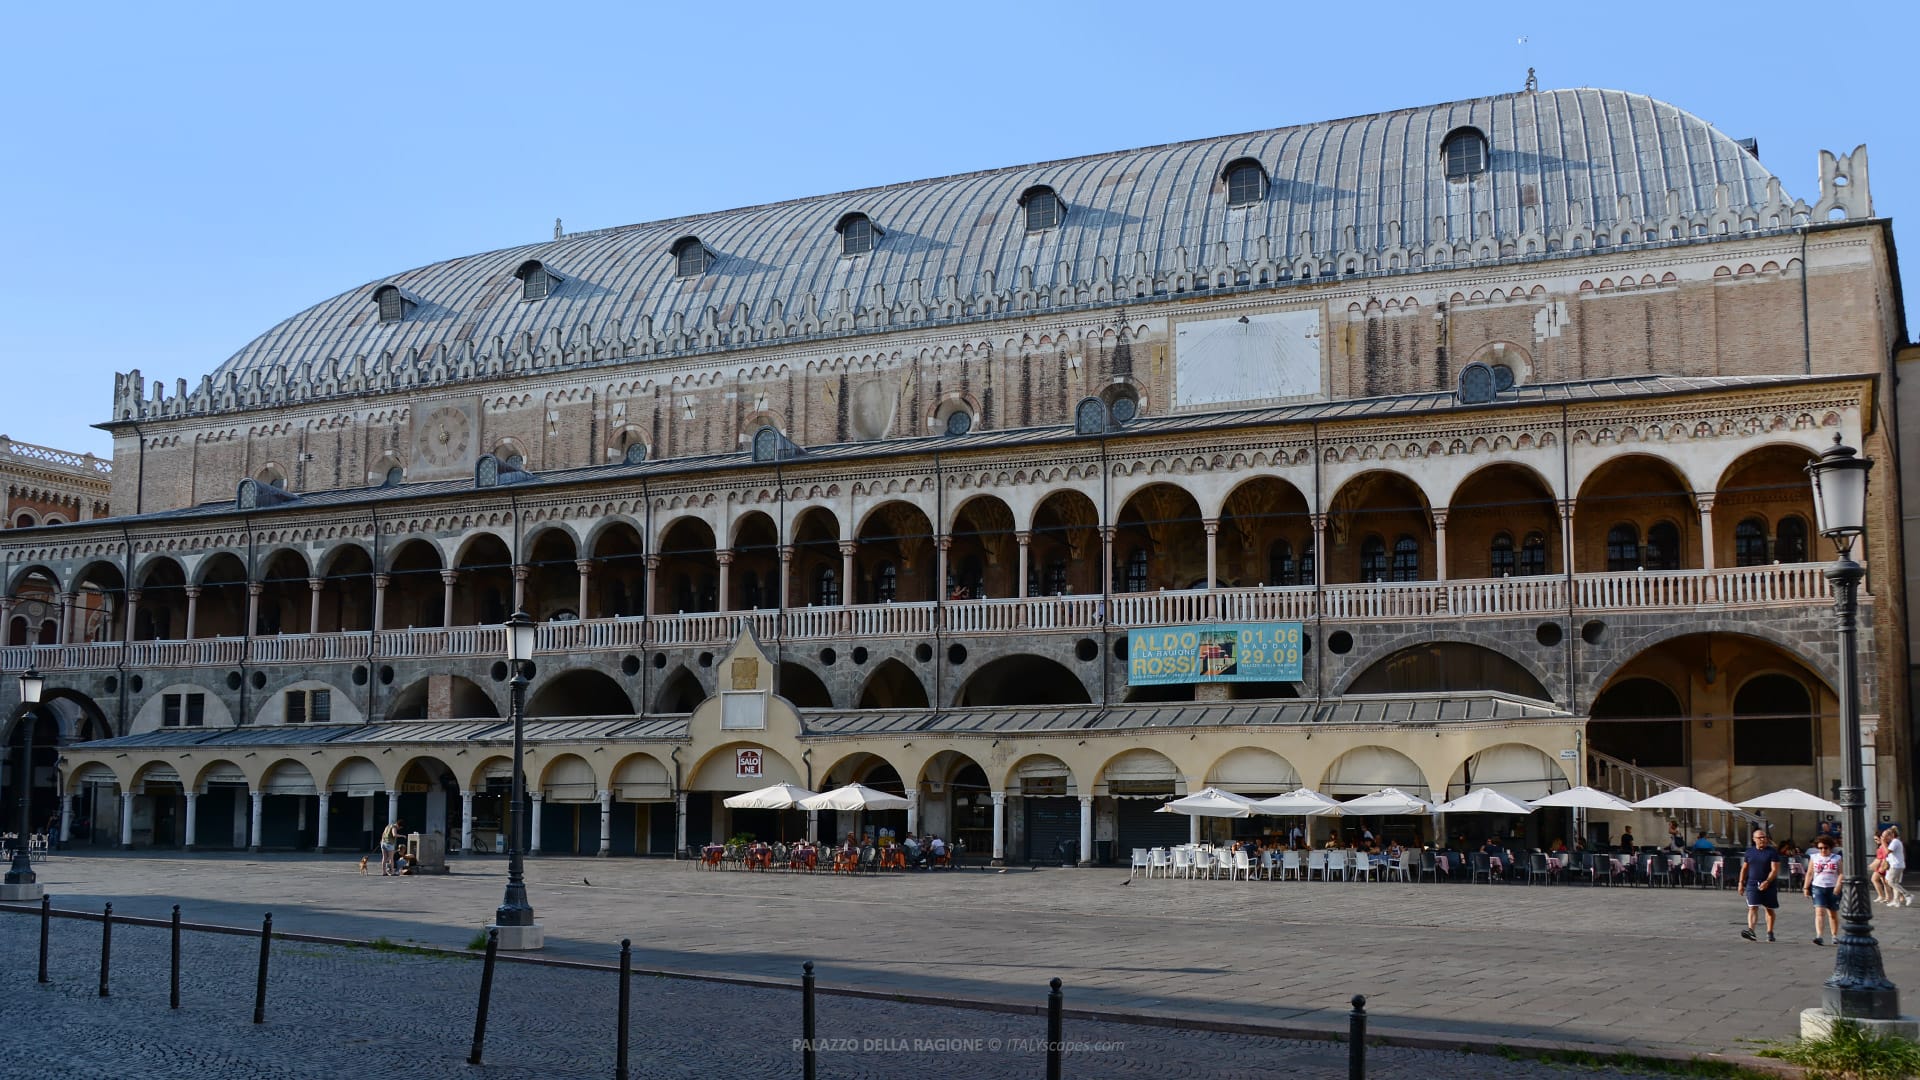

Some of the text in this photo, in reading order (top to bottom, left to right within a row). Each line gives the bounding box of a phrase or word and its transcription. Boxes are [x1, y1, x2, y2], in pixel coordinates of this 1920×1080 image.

[1132, 632, 1197, 652] ALDO
[1241, 629, 1298, 644] 01.06
[1142, 650, 1153, 659] LA
[1241, 648, 1298, 664] 29.09
[1132, 655, 1196, 676] ROSSI
